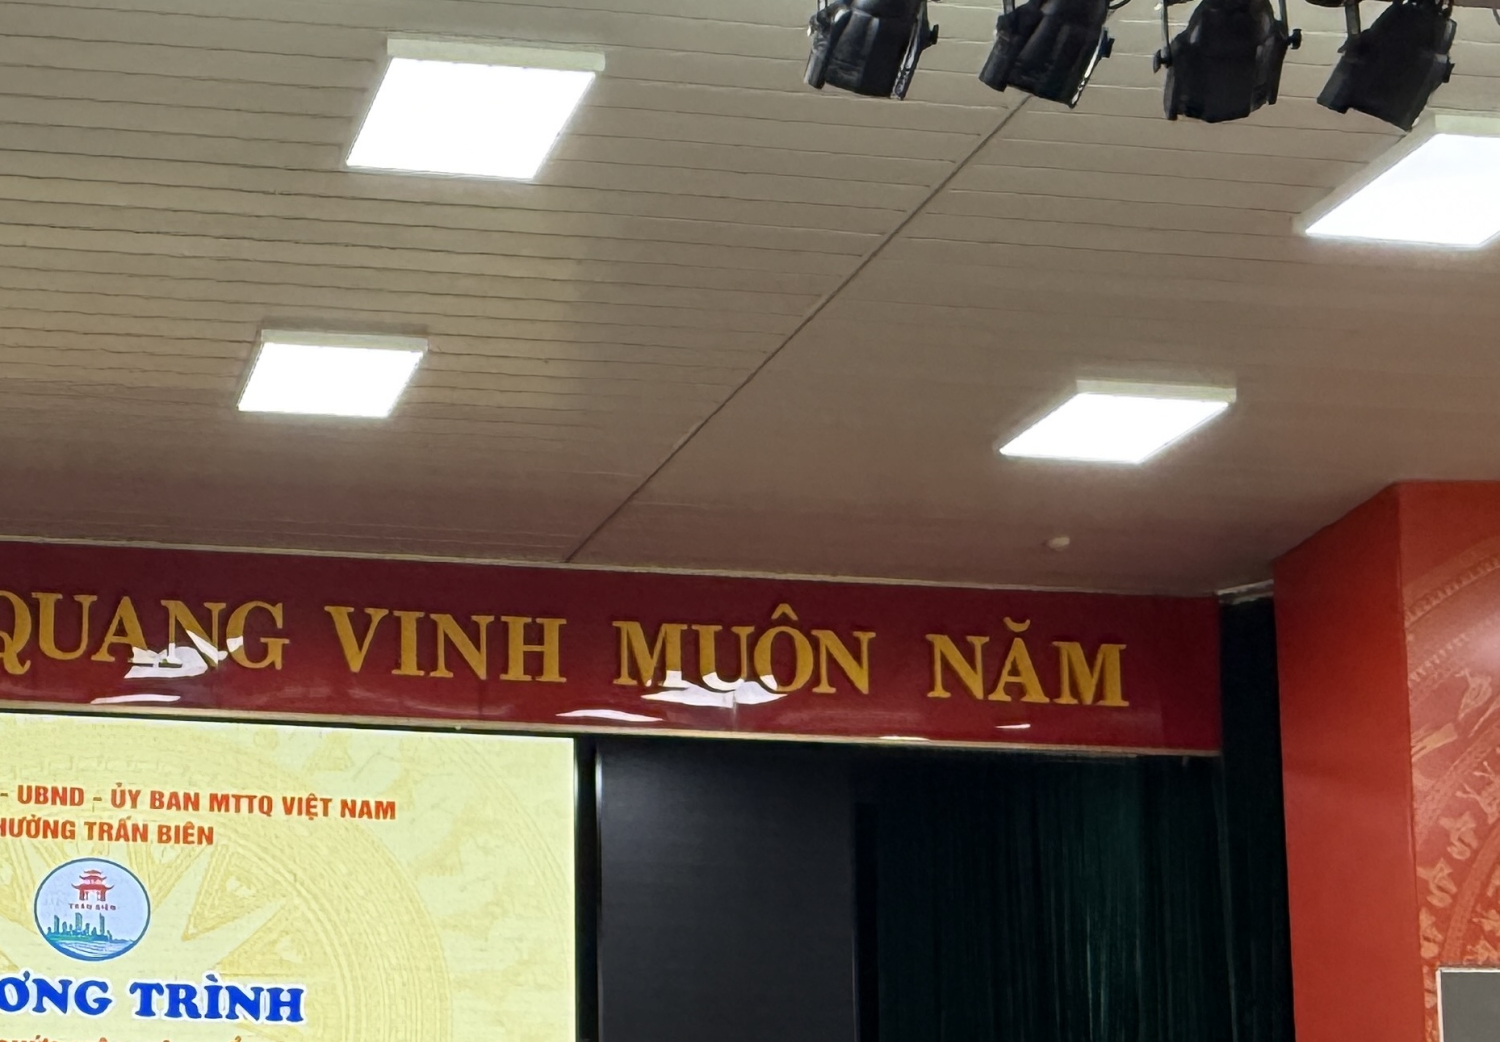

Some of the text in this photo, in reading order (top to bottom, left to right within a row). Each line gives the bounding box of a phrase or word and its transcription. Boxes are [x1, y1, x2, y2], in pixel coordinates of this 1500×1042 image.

[324, 605, 566, 683] VINH
[613, 602, 876, 694] MUÔN
[926, 616, 1130, 707] NĂM
[17, 784, 84, 806] UBND
[111, 782, 141, 809] ỦY
[149, 790, 200, 811] BAN
[209, 793, 273, 817] MTTQ
[282, 793, 332, 820] VIỆT
[340, 798, 396, 820] NAM
[84, 816, 148, 843] TRẤN
[157, 821, 214, 845] BIÊN
[129, 974, 305, 1022] TRÌNH
